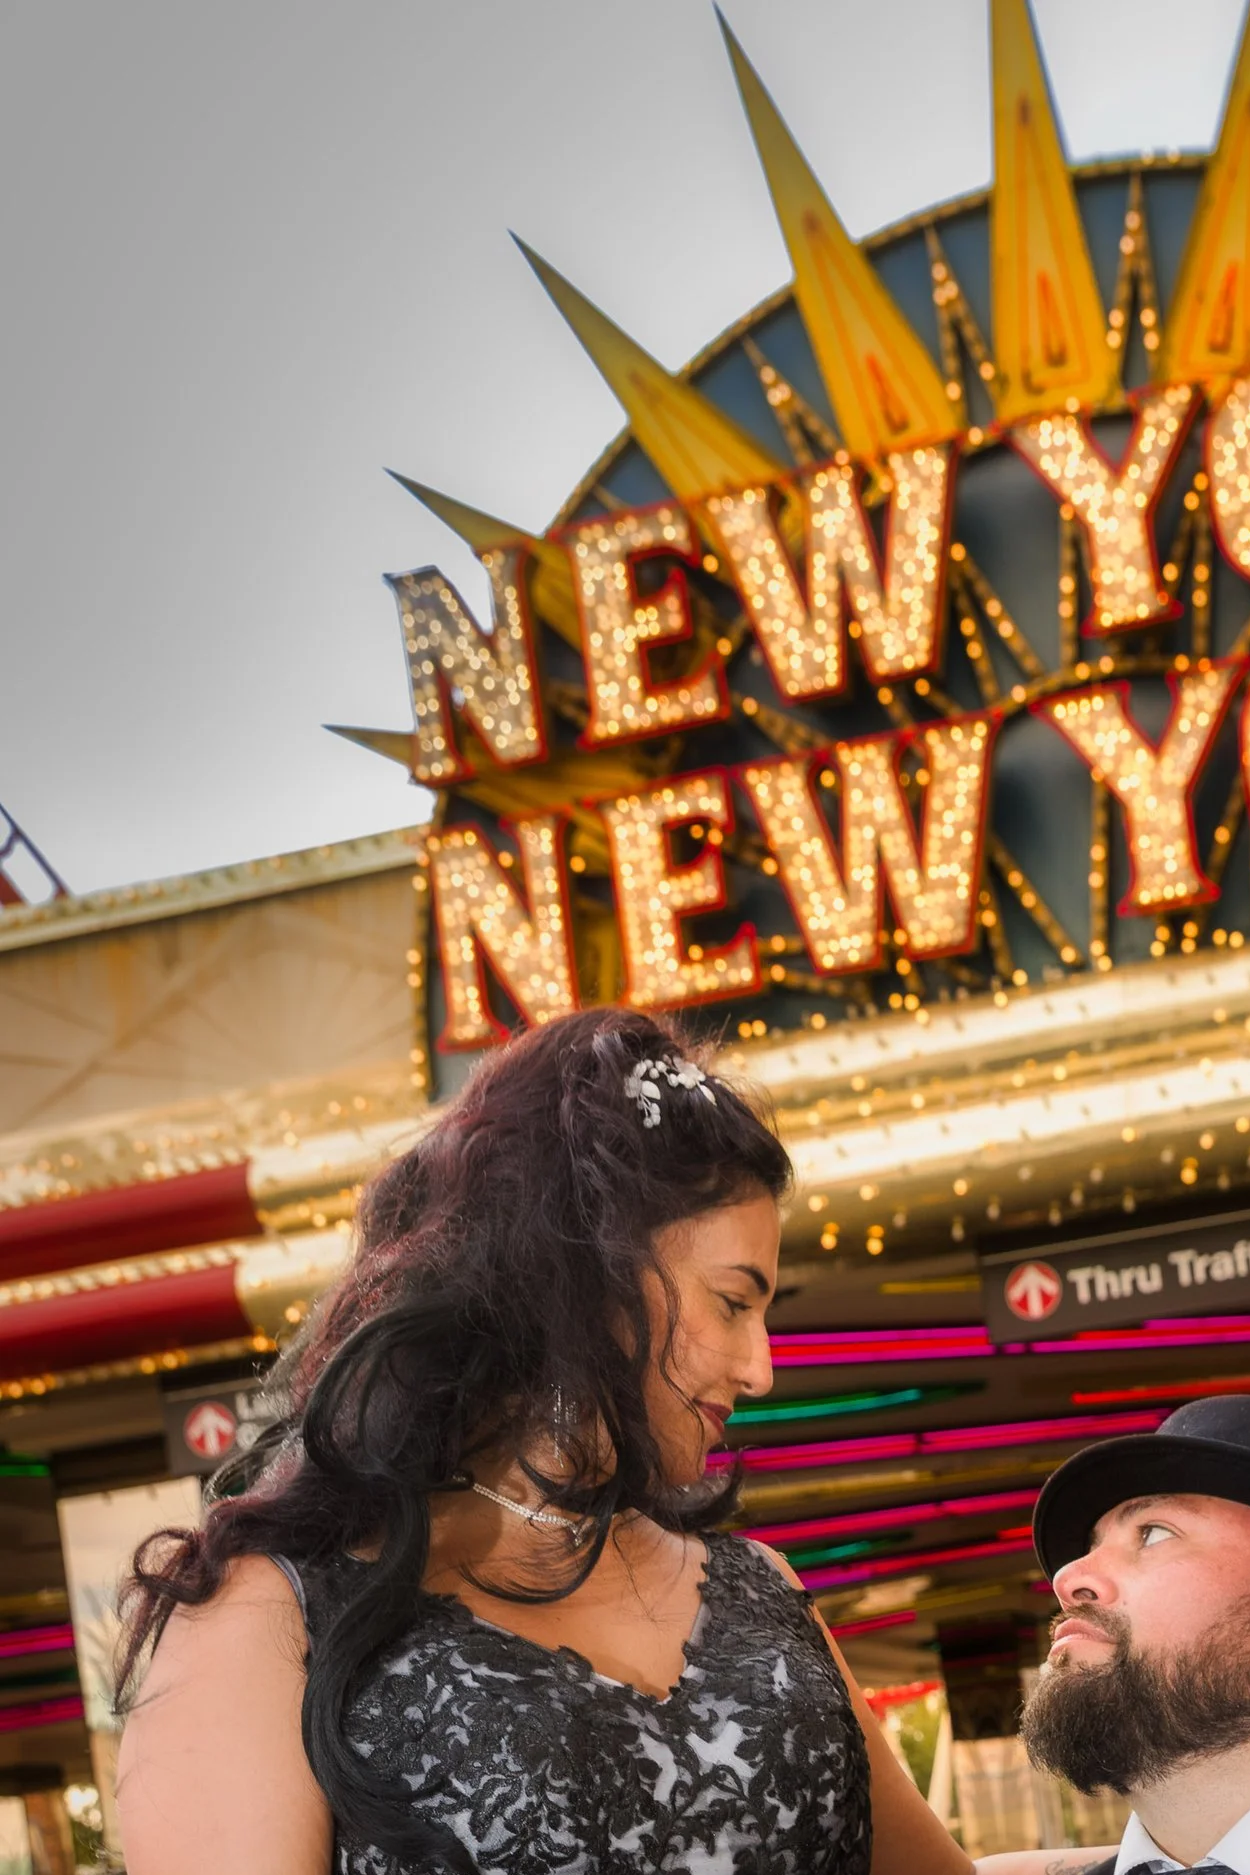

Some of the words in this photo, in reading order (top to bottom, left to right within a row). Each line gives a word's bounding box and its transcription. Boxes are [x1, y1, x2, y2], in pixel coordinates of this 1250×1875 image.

[384, 437, 960, 788] NEW
[420, 710, 1003, 1053] NEW
[1067, 1264, 1163, 1305] Thru
